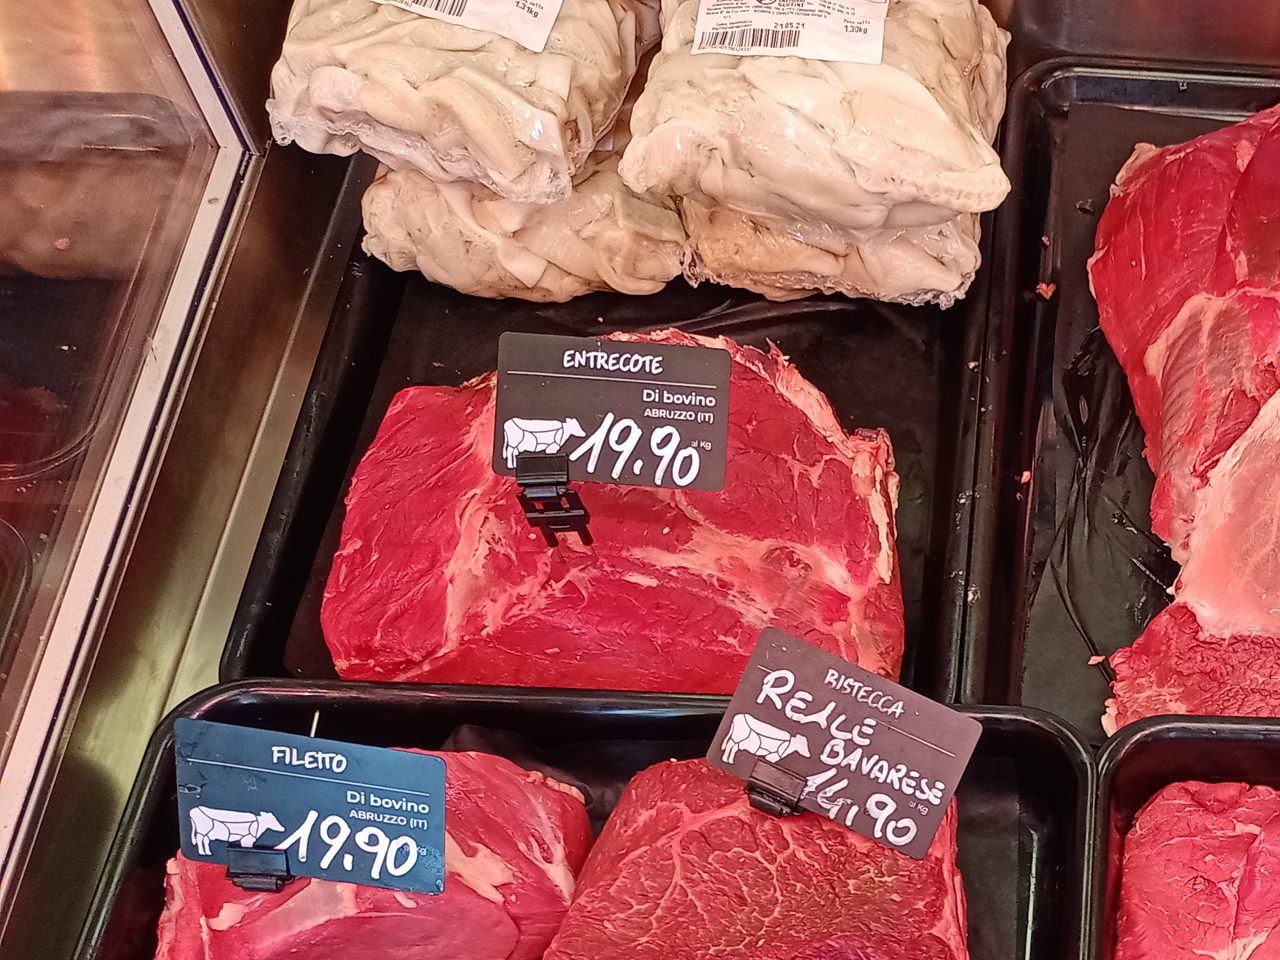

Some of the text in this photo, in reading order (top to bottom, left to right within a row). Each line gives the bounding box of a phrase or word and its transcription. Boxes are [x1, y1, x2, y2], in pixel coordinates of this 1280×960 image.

[564, 350, 664, 374] ENTRECOTE
[642, 389, 716, 406] Di bovino
[644, 408, 714, 424] ABRUZZO (IT)
[700, 440, 712, 450] Kg
[824, 668, 904, 718] BISTECCA
[756, 670, 877, 746] REALE
[272, 746, 348, 773] FILETTO
[820, 738, 946, 805] BAVARESE
[346, 790, 430, 814] Di bovino
[917, 804, 928, 816] Kg
[349, 809, 428, 830] ABRUZZO (IT)
